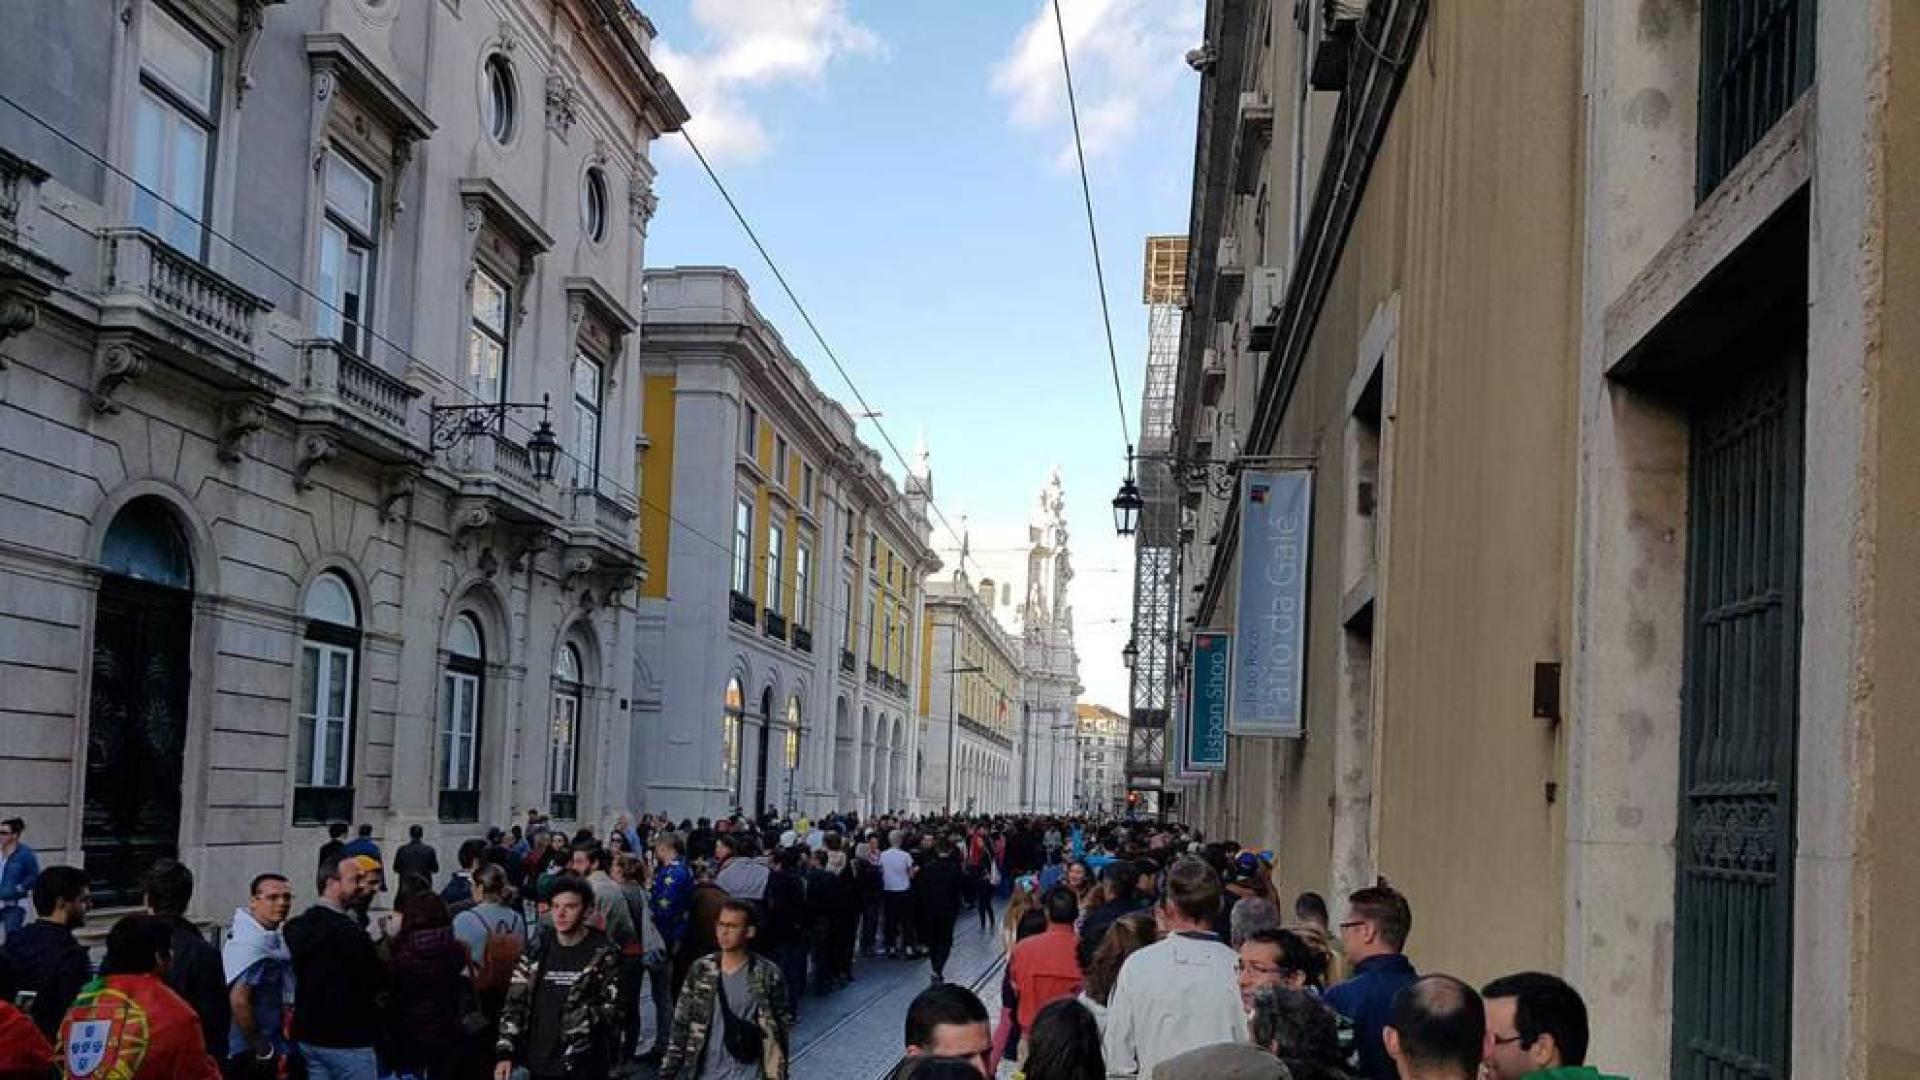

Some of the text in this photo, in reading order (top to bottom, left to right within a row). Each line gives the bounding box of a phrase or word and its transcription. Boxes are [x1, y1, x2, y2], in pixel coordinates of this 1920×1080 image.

[1265, 512, 1299, 586] Galé
[1258, 596, 1296, 634] da
[1203, 703, 1223, 761] Lisbon
